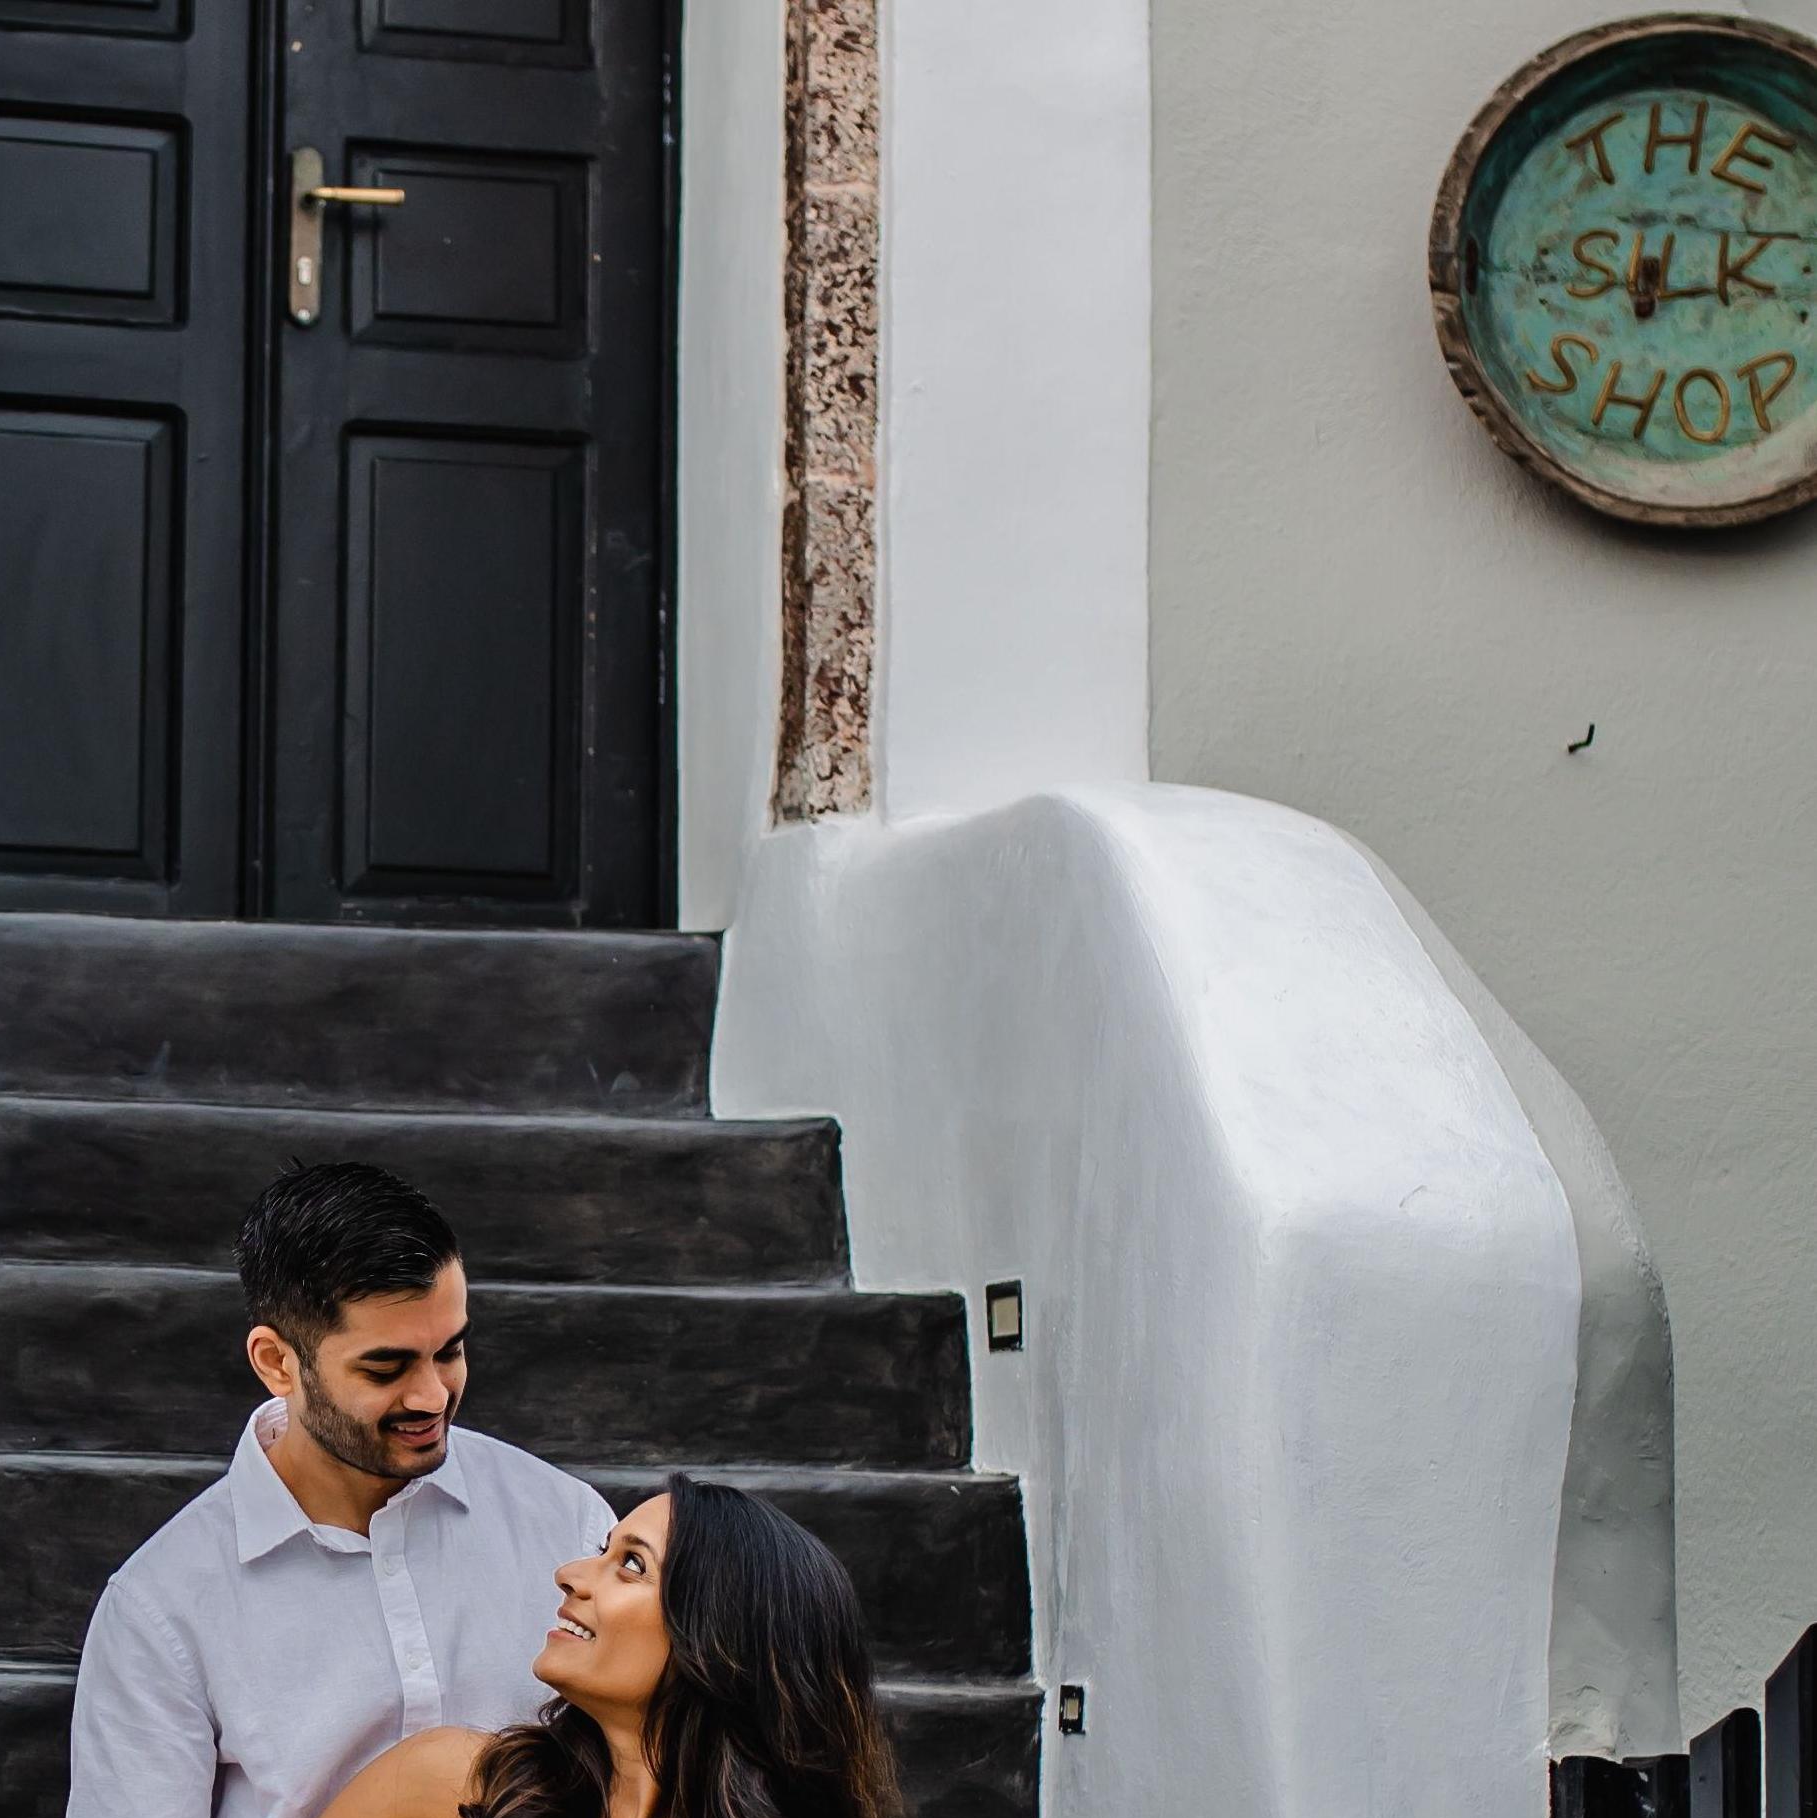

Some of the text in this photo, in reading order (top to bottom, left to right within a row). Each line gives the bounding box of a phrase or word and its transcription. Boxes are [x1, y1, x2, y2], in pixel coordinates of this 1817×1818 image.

[1566, 100, 1797, 195] THE
[1566, 230, 1777, 305] SILK
[1526, 335, 1797, 445] SHOP
